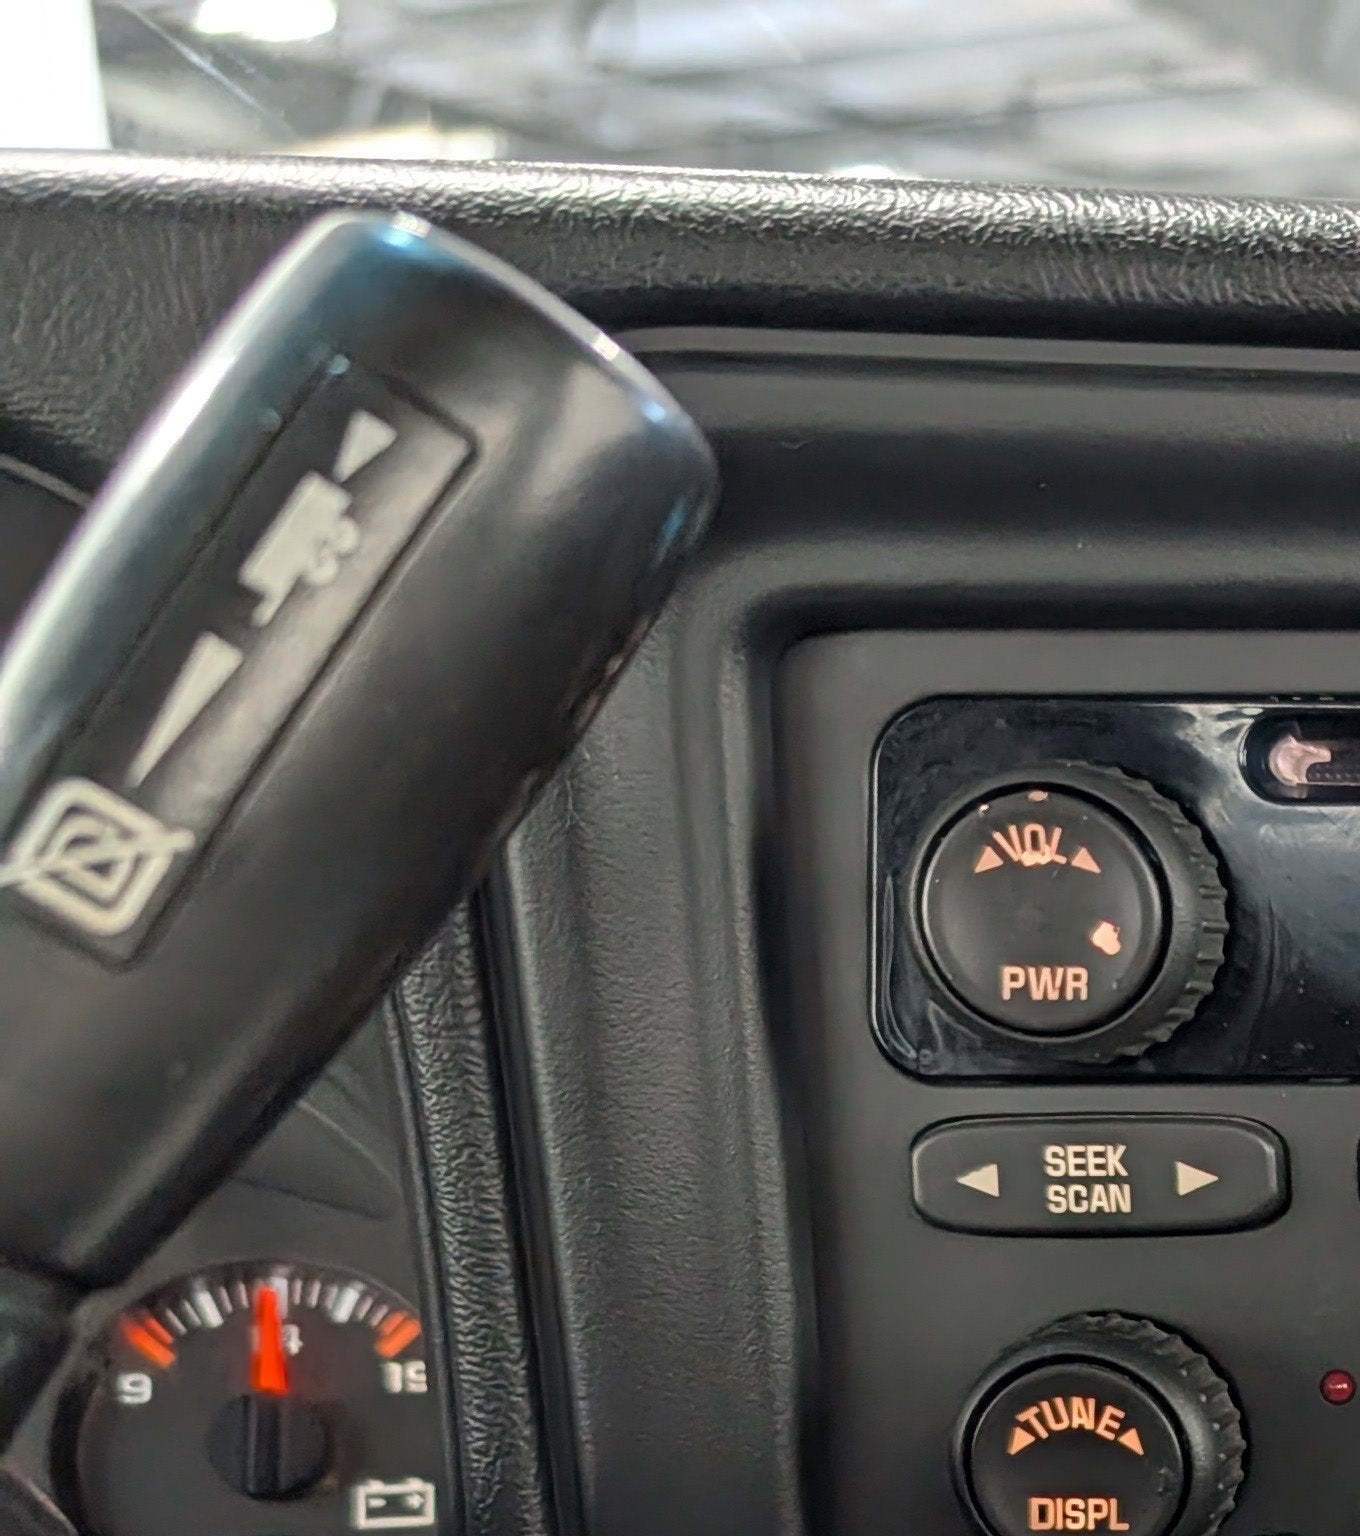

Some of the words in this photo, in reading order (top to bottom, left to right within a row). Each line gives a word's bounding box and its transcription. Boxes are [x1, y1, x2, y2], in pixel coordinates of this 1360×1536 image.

[991, 822, 1068, 867] VOL
[1001, 965, 1089, 1001] PWR
[1044, 1144, 1129, 1177] SEEK
[1046, 1183, 1132, 1214] SCAN
[118, 1372, 153, 1405] 9
[1015, 1396, 1126, 1442] TUNE
[1028, 1497, 1130, 1531] DISPL
